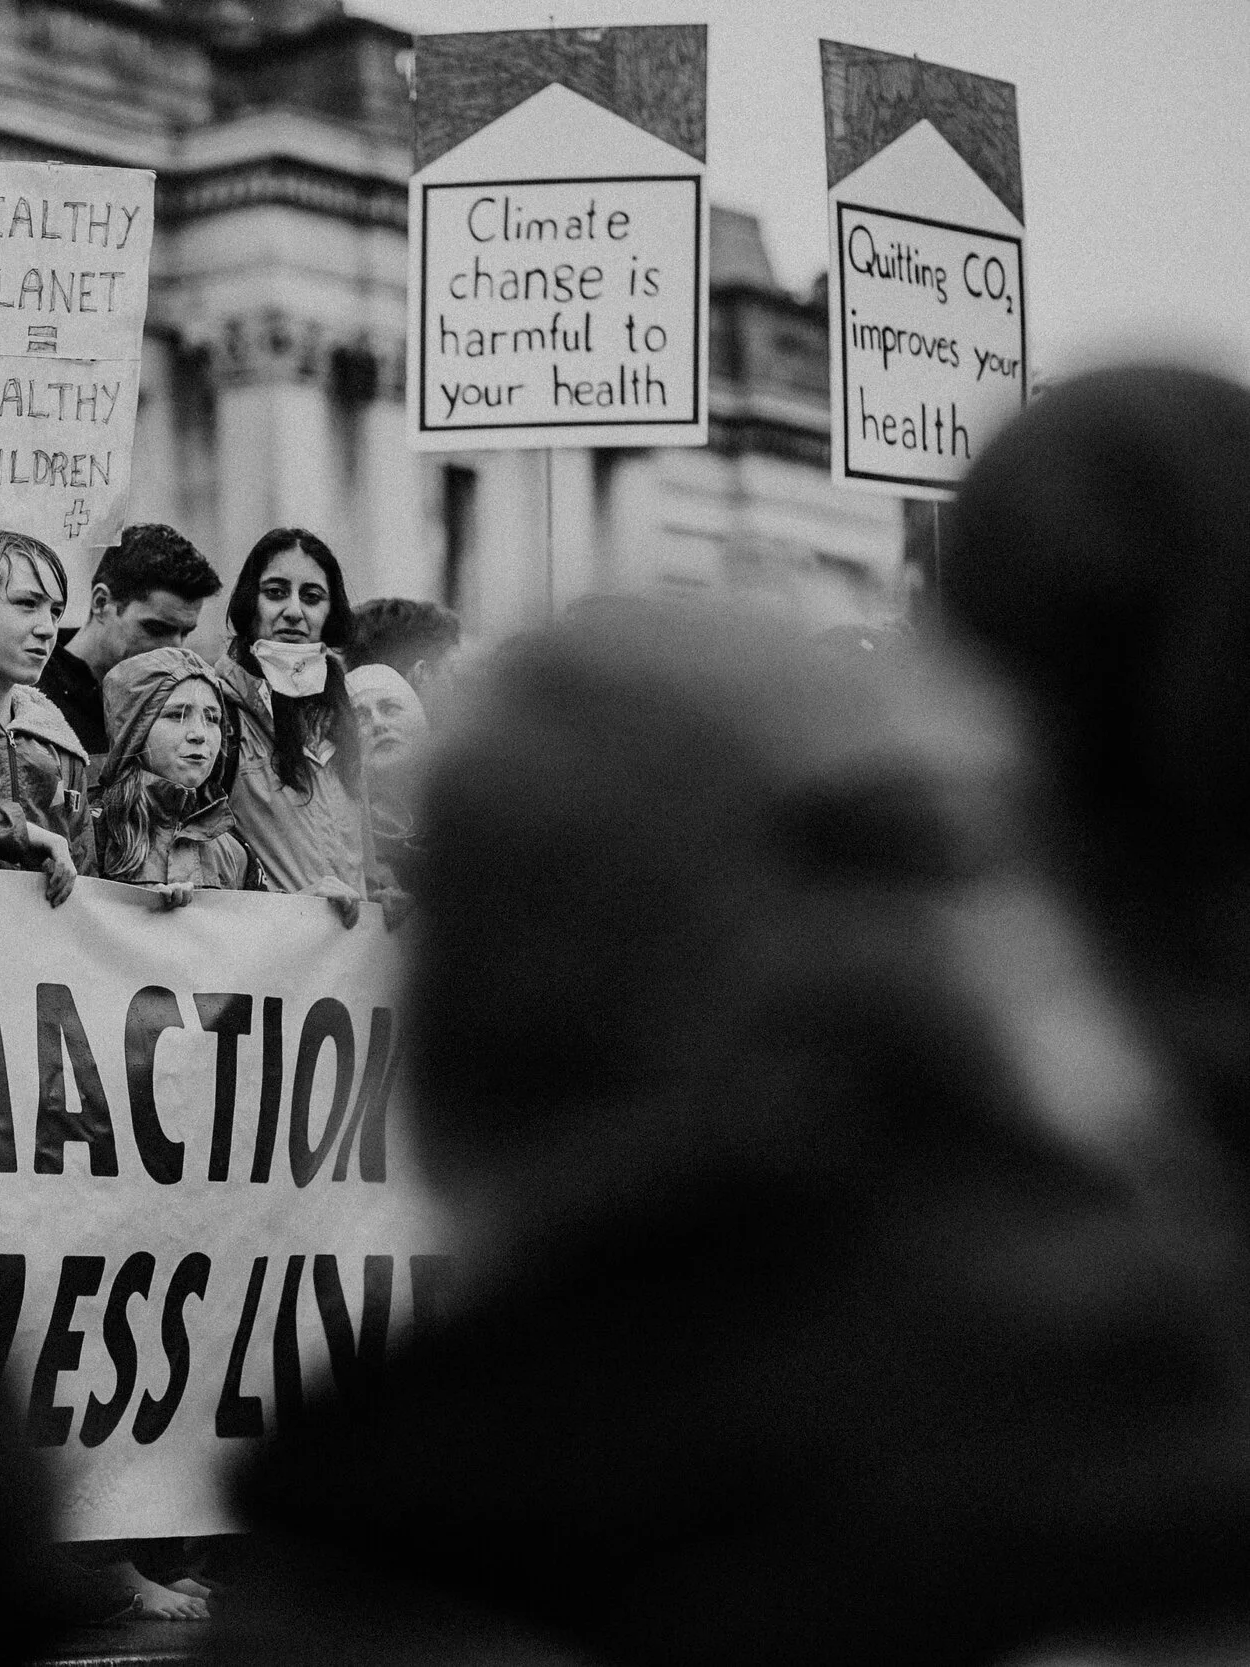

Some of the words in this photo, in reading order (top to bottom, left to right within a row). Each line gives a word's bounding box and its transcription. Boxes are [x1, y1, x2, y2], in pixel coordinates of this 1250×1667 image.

[467, 195, 631, 242] Climate
[449, 254, 604, 303] change
[629, 254, 661, 297] is
[848, 224, 949, 305] Quitting
[439, 311, 594, 358] harmful
[624, 313, 668, 353] to
[850, 308, 961, 371] improves
[973, 346, 1021, 382] your
[439, 383, 525, 420] your
[552, 363, 668, 407] health
[858, 384, 971, 460] health
